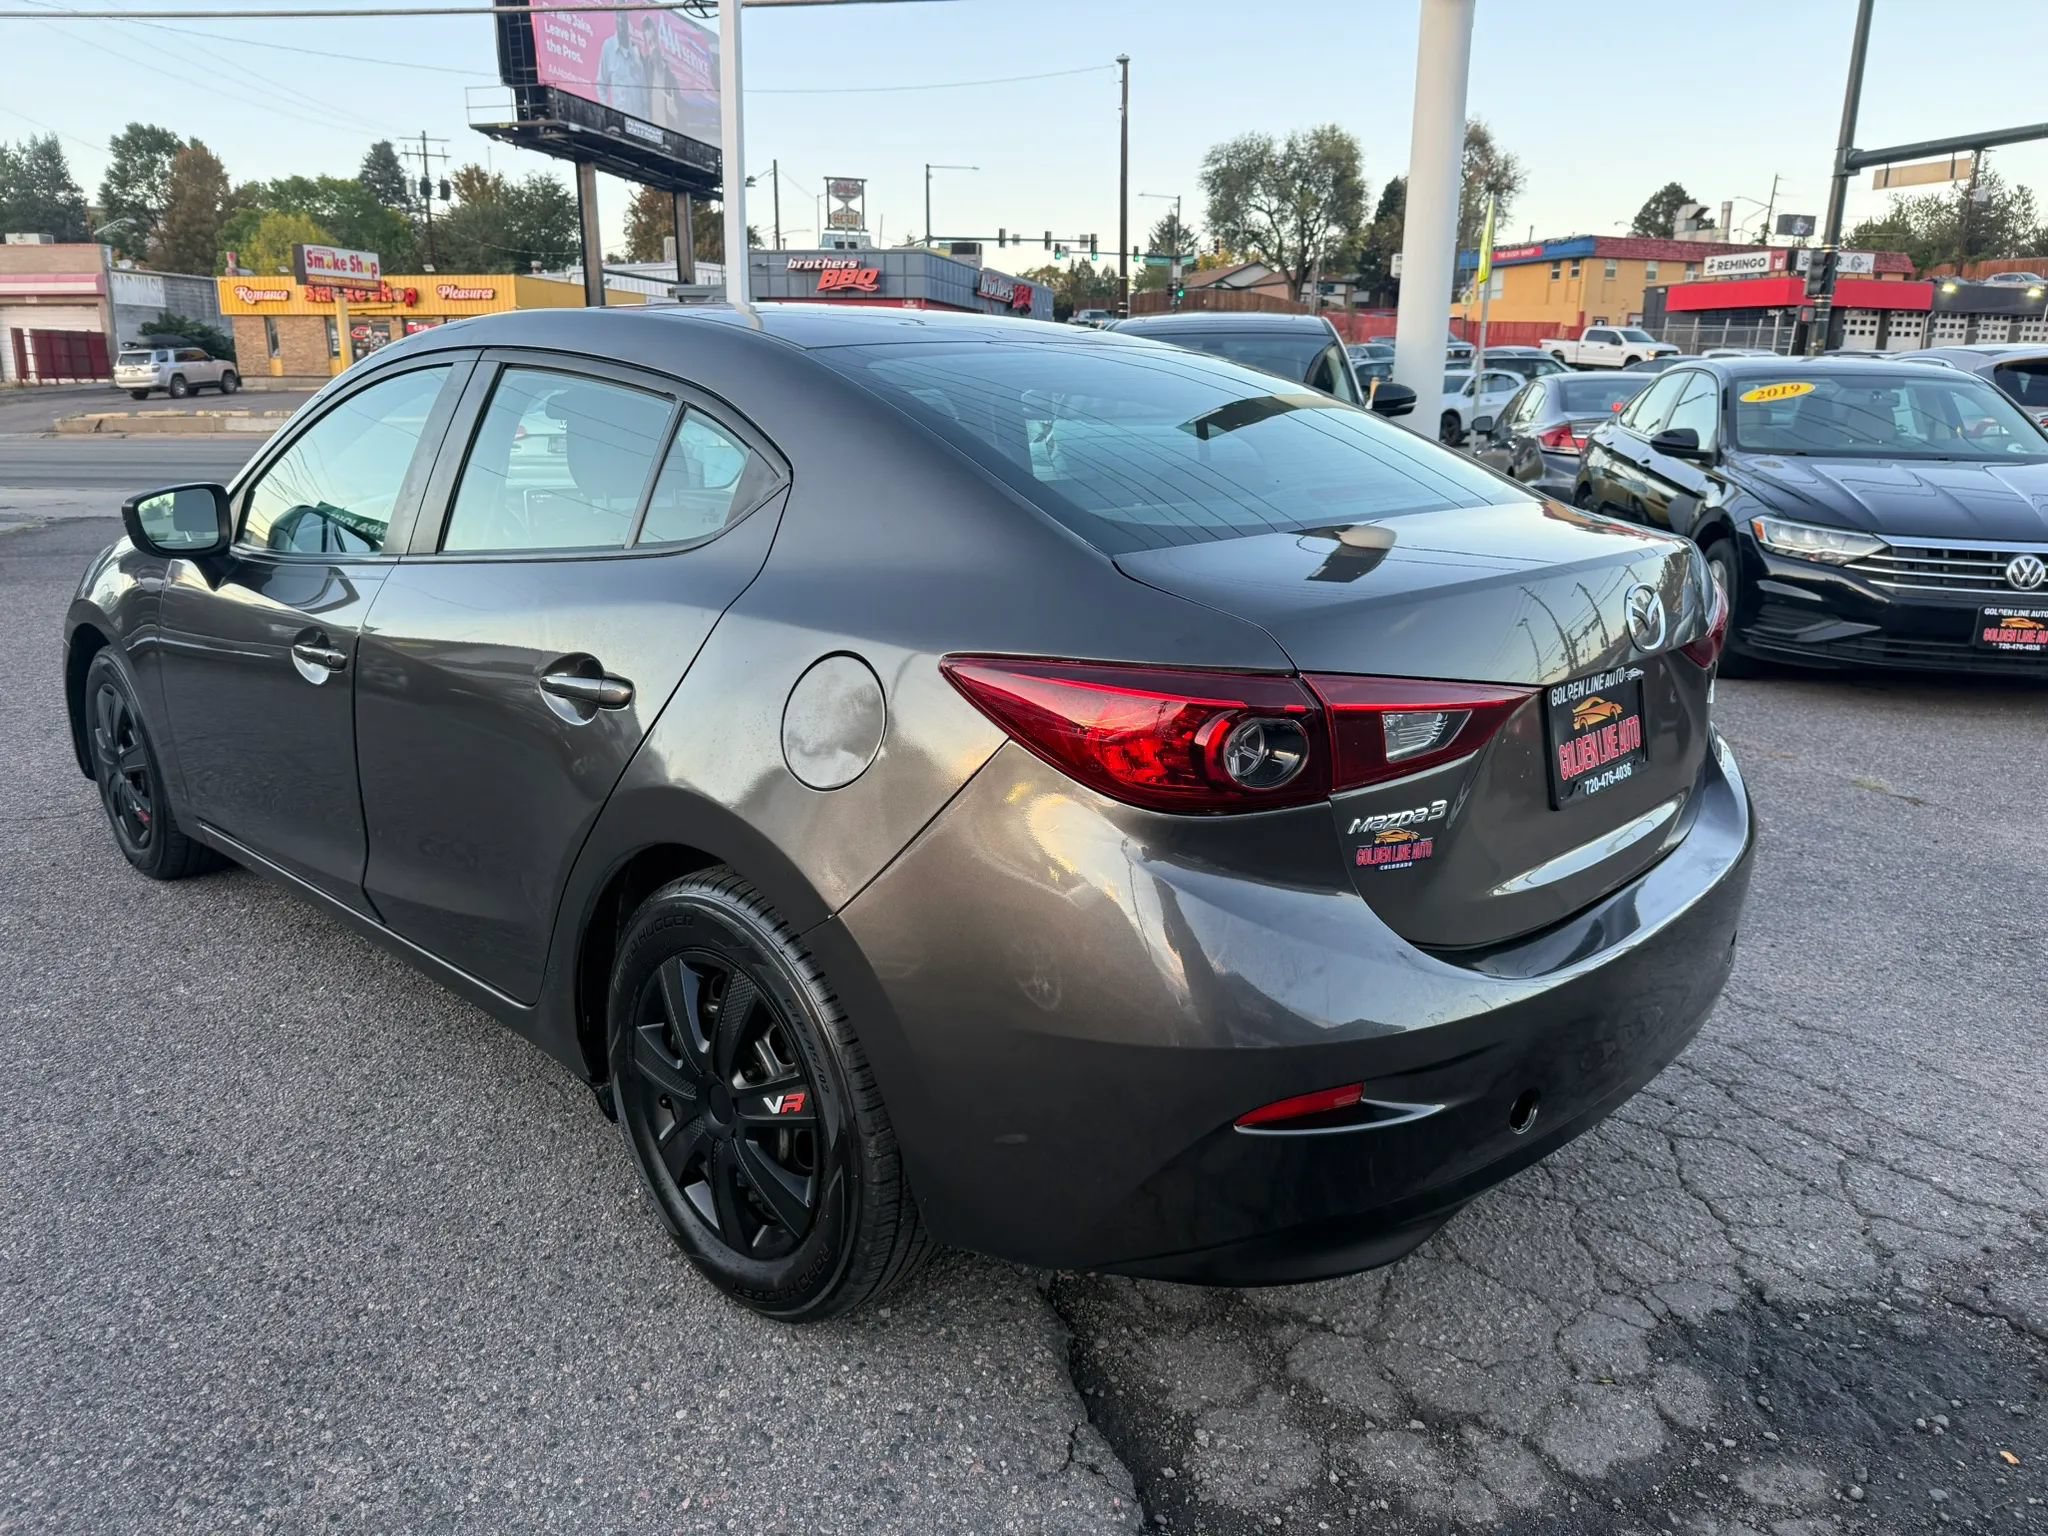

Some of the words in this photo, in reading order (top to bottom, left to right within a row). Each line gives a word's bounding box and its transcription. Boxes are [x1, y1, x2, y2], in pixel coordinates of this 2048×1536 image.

[786, 258, 858, 270] brothers
[1716, 257, 1766, 271] REMINGO
[817, 269, 880, 291] BBQ
[234, 286, 289, 305] Romance
[437, 285, 494, 301] Pleasures
[1756, 383, 1801, 401] 2019
[1984, 607, 2013, 616] GOLDEN
[2013, 609, 2030, 617] LINE
[1983, 627, 2017, 643] GOLDEN
[2016, 628, 2036, 644] LINE
[1551, 679, 1585, 707] GOLDEN
[1585, 672, 1605, 695] LINE
[1604, 666, 1625, 689] AUTO
[1558, 730, 1599, 781] GOLDEN
[1597, 724, 1619, 765] LINE
[1618, 714, 1641, 755] AUTO
[1585, 762, 1632, 795] 720-476-4036
[1356, 845, 1392, 866] GOLDEN
[1391, 842, 1411, 863] LINE
[1411, 840, 1433, 860] AUTO
[1379, 861, 1413, 871] COLORADO
[763, 1093, 806, 1114] VR
